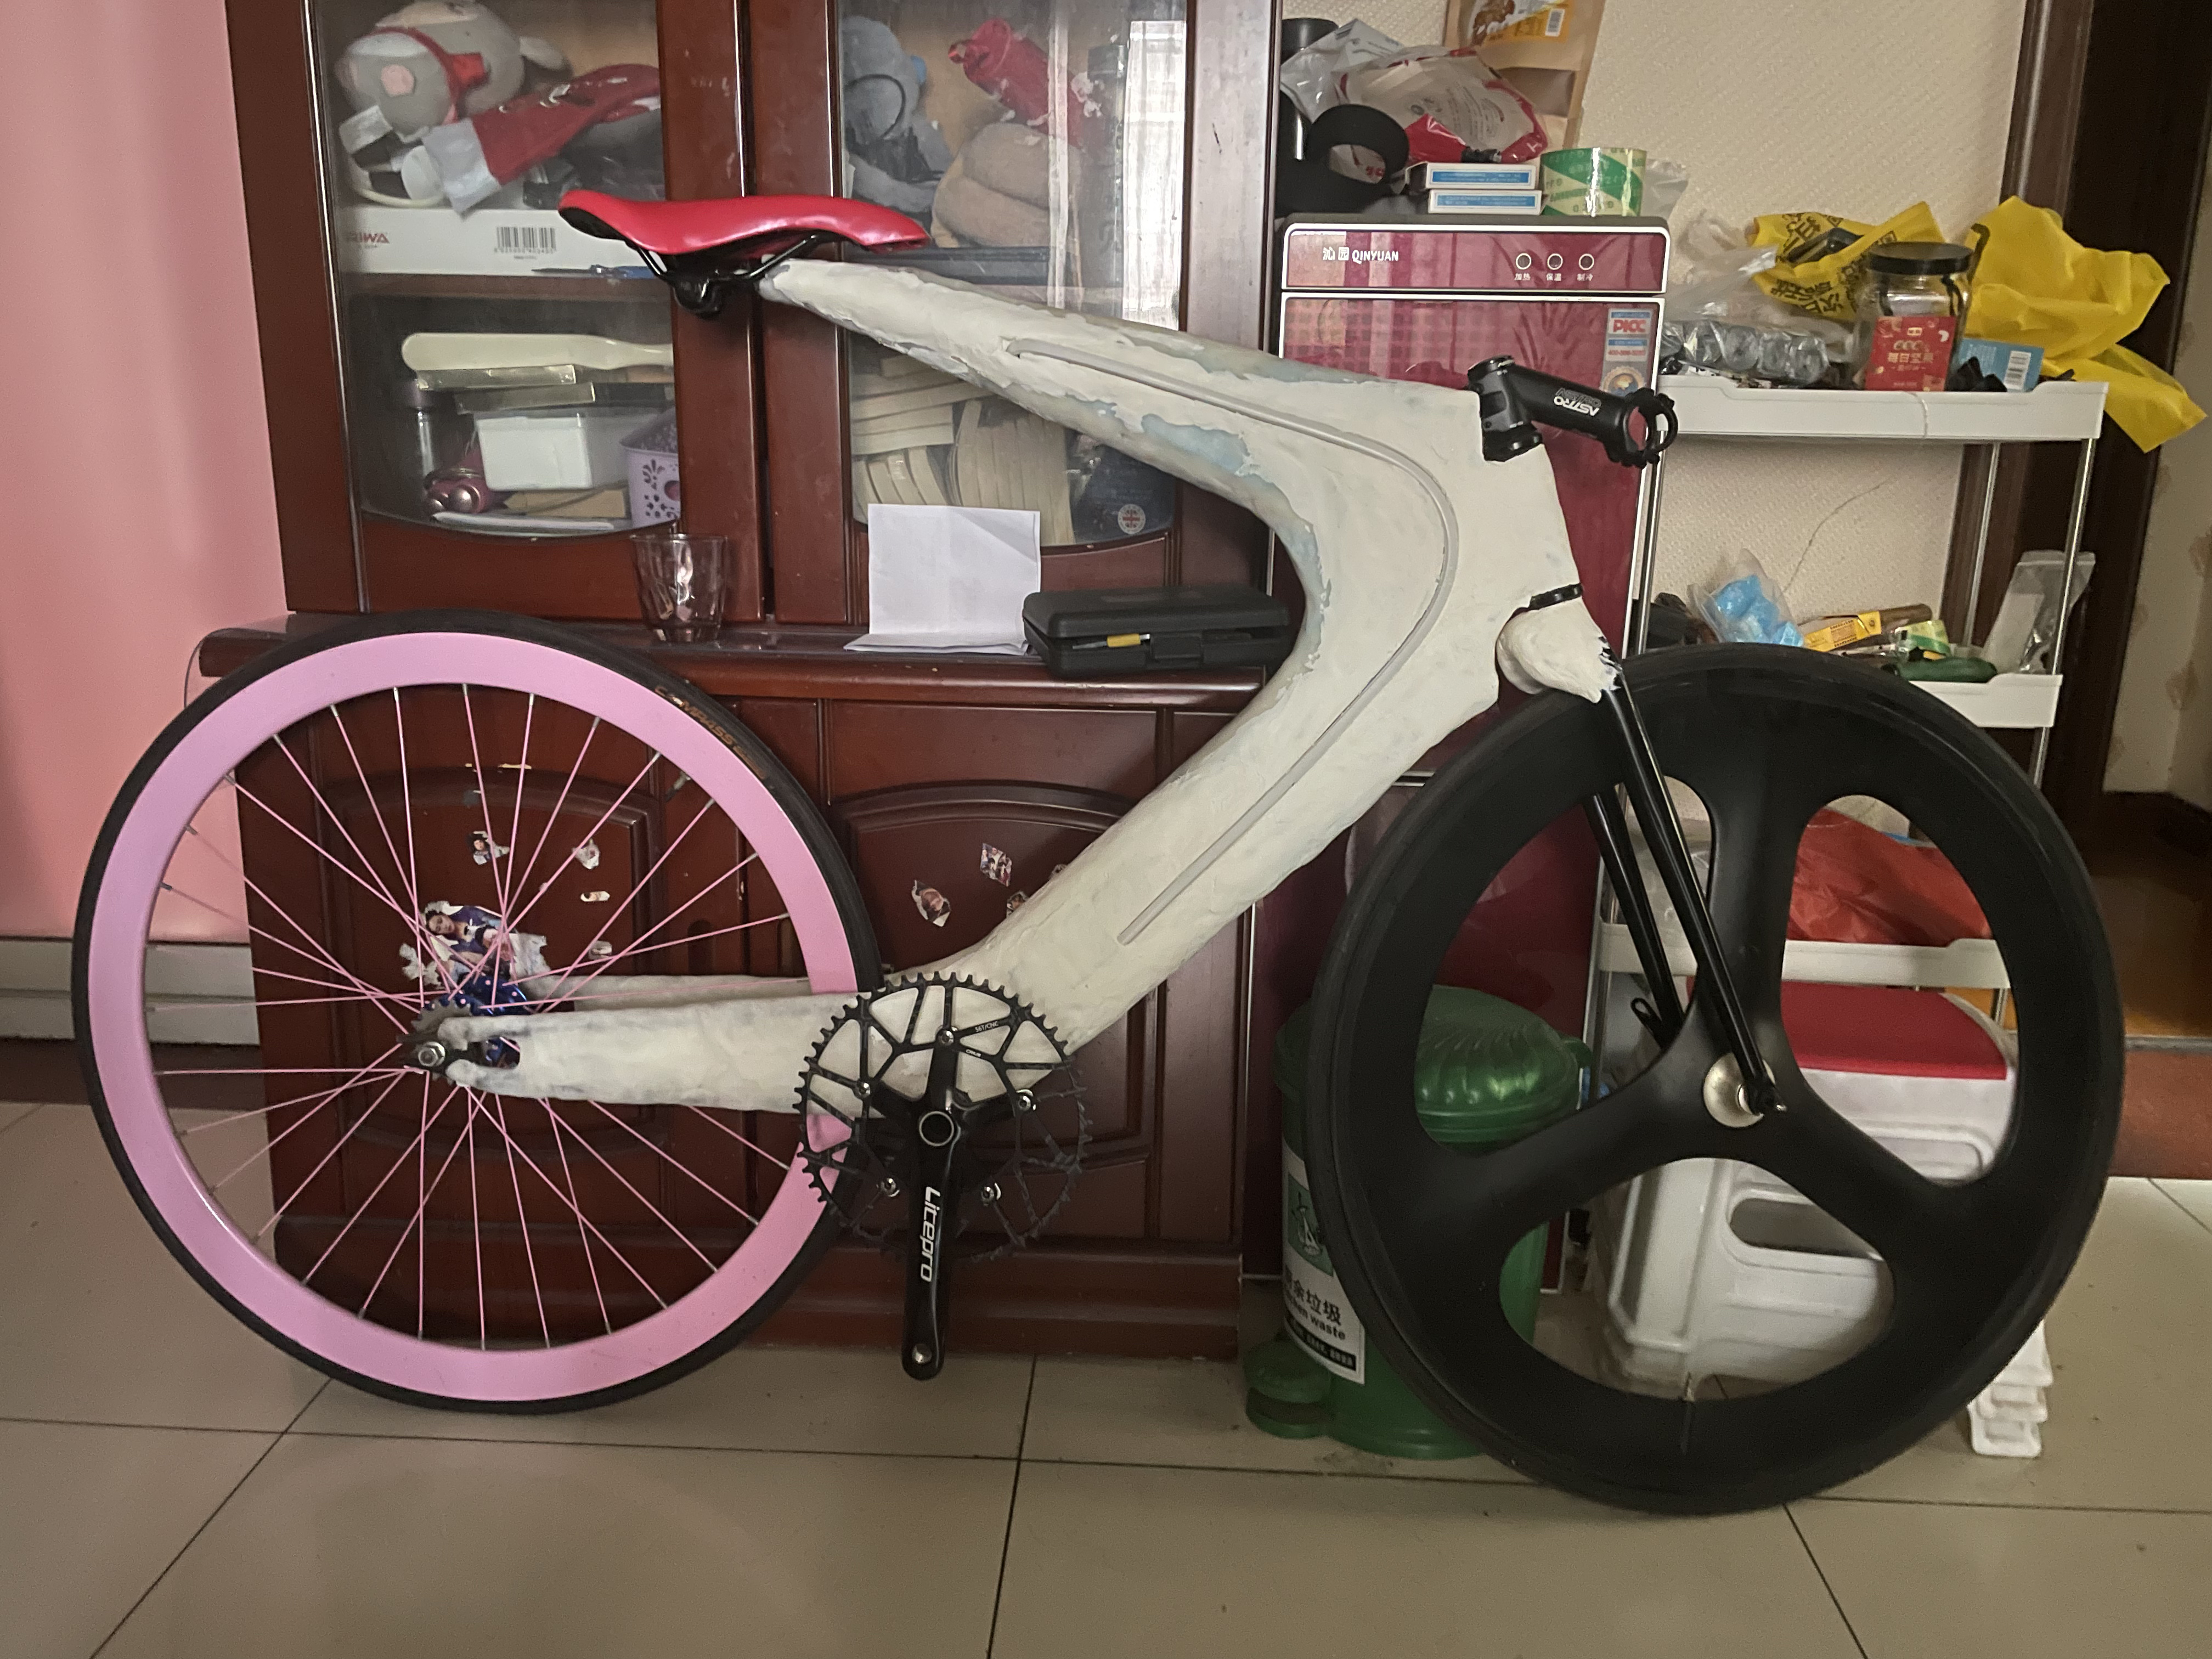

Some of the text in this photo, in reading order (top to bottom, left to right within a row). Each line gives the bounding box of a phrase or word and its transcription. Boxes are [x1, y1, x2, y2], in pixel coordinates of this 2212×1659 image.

[1352, 250, 1399, 264] QINYUAN
[1553, 396, 1600, 416] ASTRO
[919, 1186, 940, 1283] Litepro
[1310, 1314, 1346, 1340] waste
